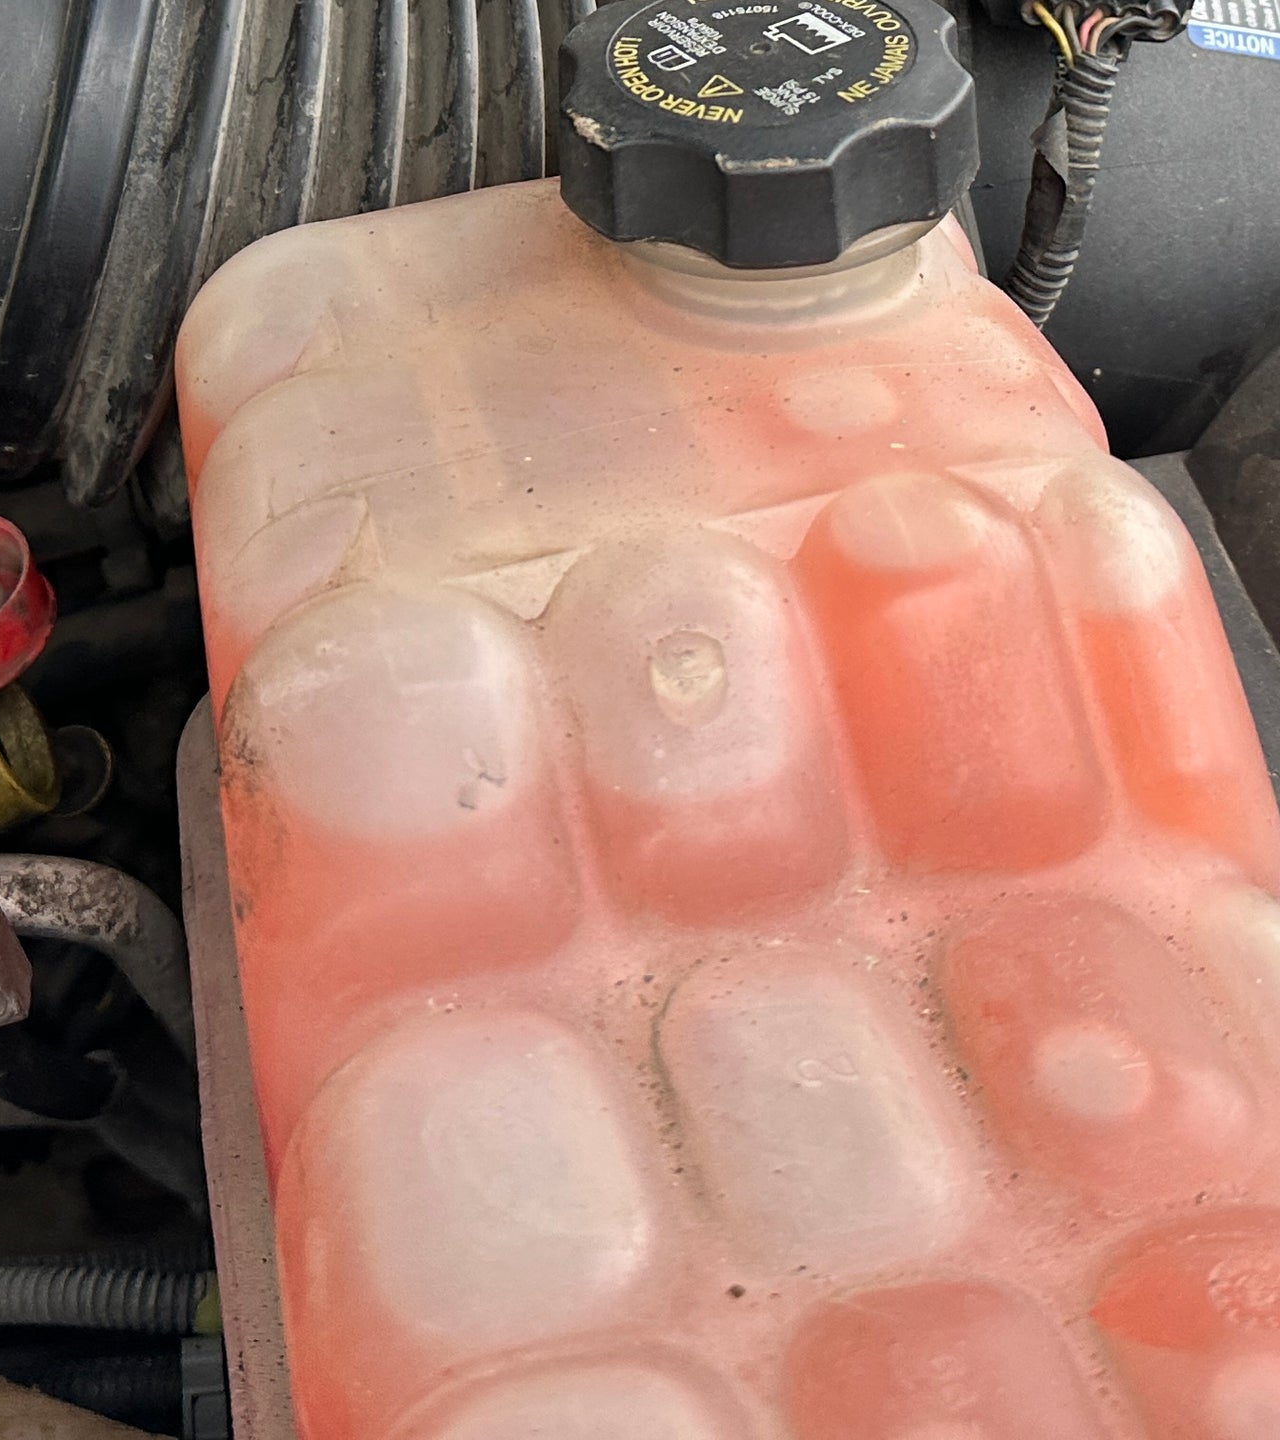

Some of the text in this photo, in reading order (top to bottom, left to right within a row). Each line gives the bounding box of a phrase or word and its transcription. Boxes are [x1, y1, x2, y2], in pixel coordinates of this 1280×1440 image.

[1203, 28, 1275, 56] NOTICE
[613, 37, 744, 123] NEVER OPEN HOT!
[836, 80, 880, 103] NE
[869, 35, 909, 84] JAMAIS
[754, 85, 800, 116] SURGE
